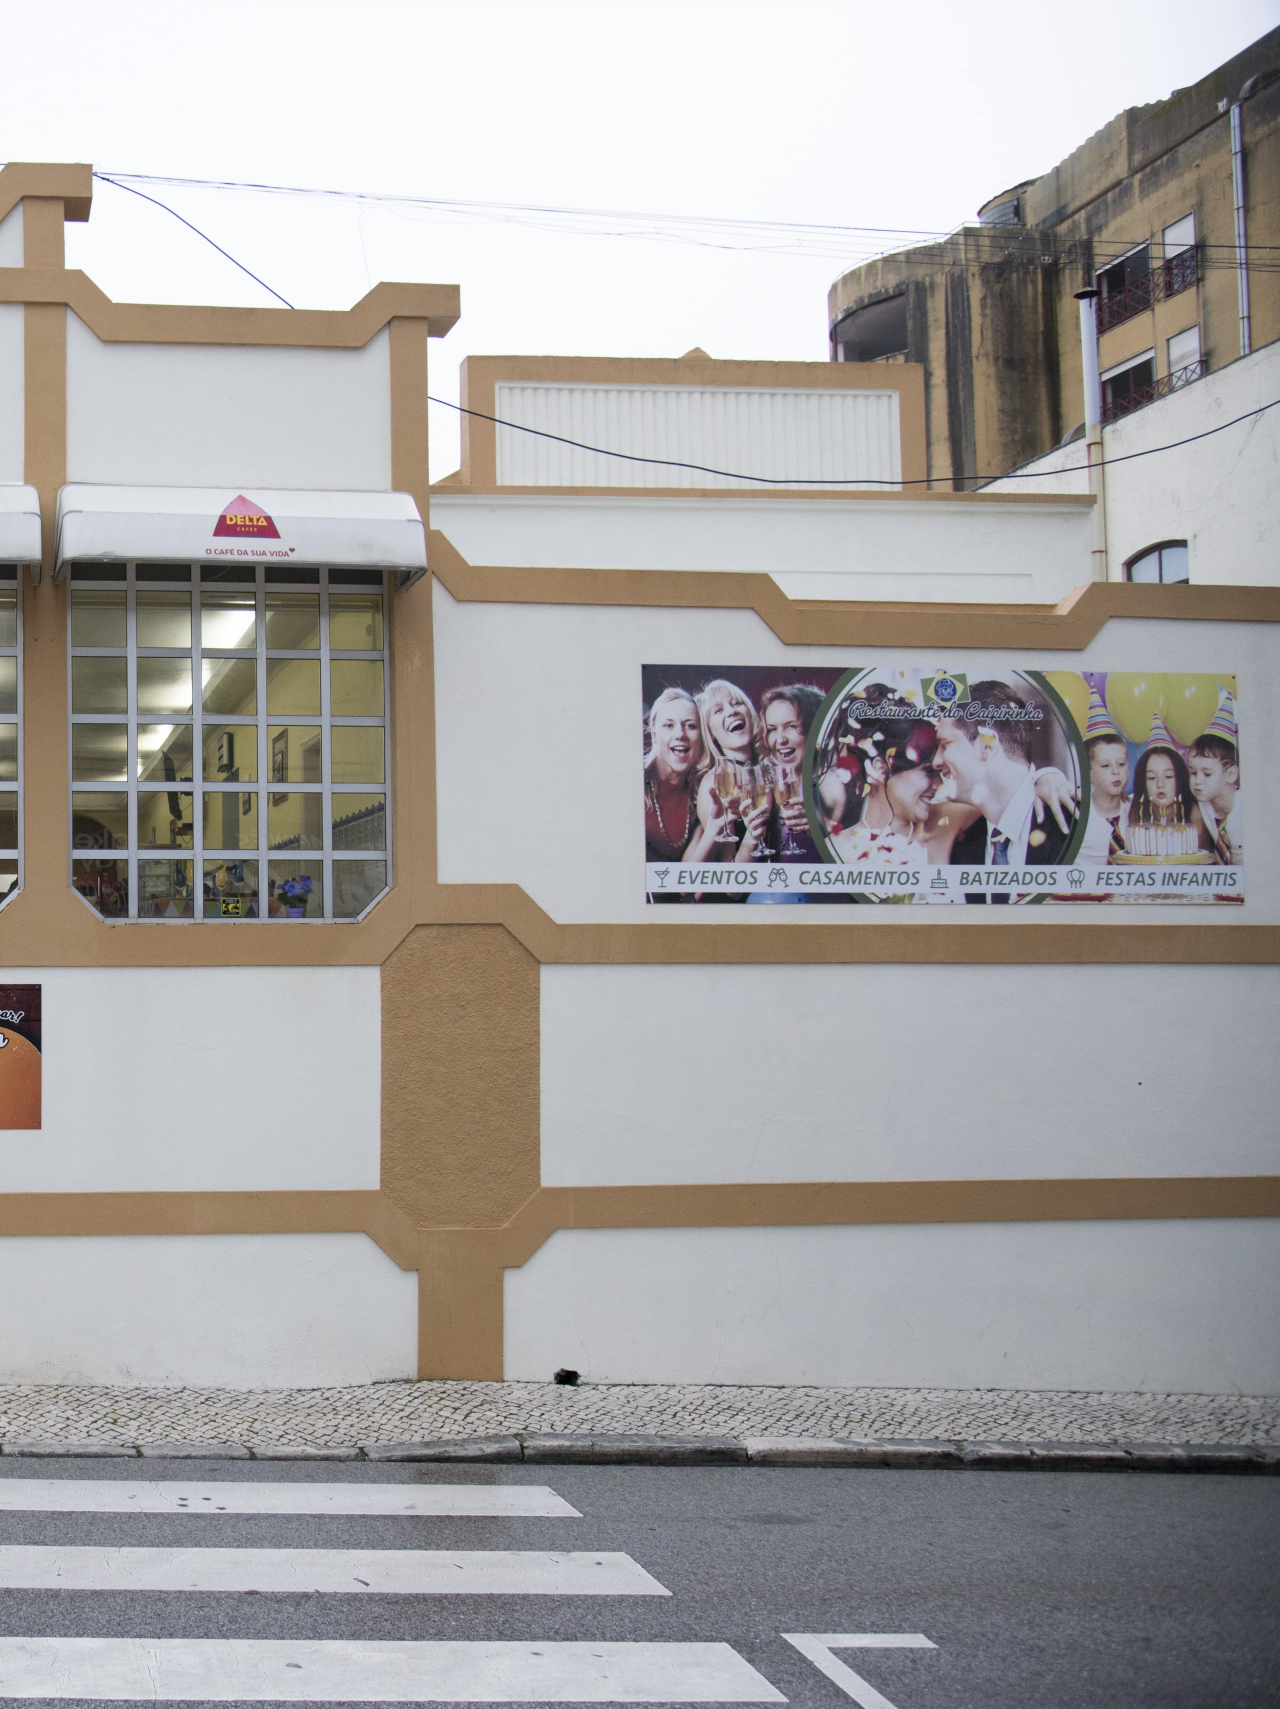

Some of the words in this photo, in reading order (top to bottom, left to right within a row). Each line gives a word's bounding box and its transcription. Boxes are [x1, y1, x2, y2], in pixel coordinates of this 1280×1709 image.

[226, 515, 268, 526] DELTA
[214, 548, 235, 556] CAFÉ
[847, 700, 942, 720] Restaurante
[943, 701, 963, 720] do
[964, 700, 1043, 727] Caipirinha
[677, 870, 758, 886] EVENTOS
[798, 870, 921, 886] CASAMENTOS
[959, 871, 1058, 886] BATIZADOS
[1096, 871, 1157, 887] FESTAS
[1161, 872, 1238, 887] INFANTIS
